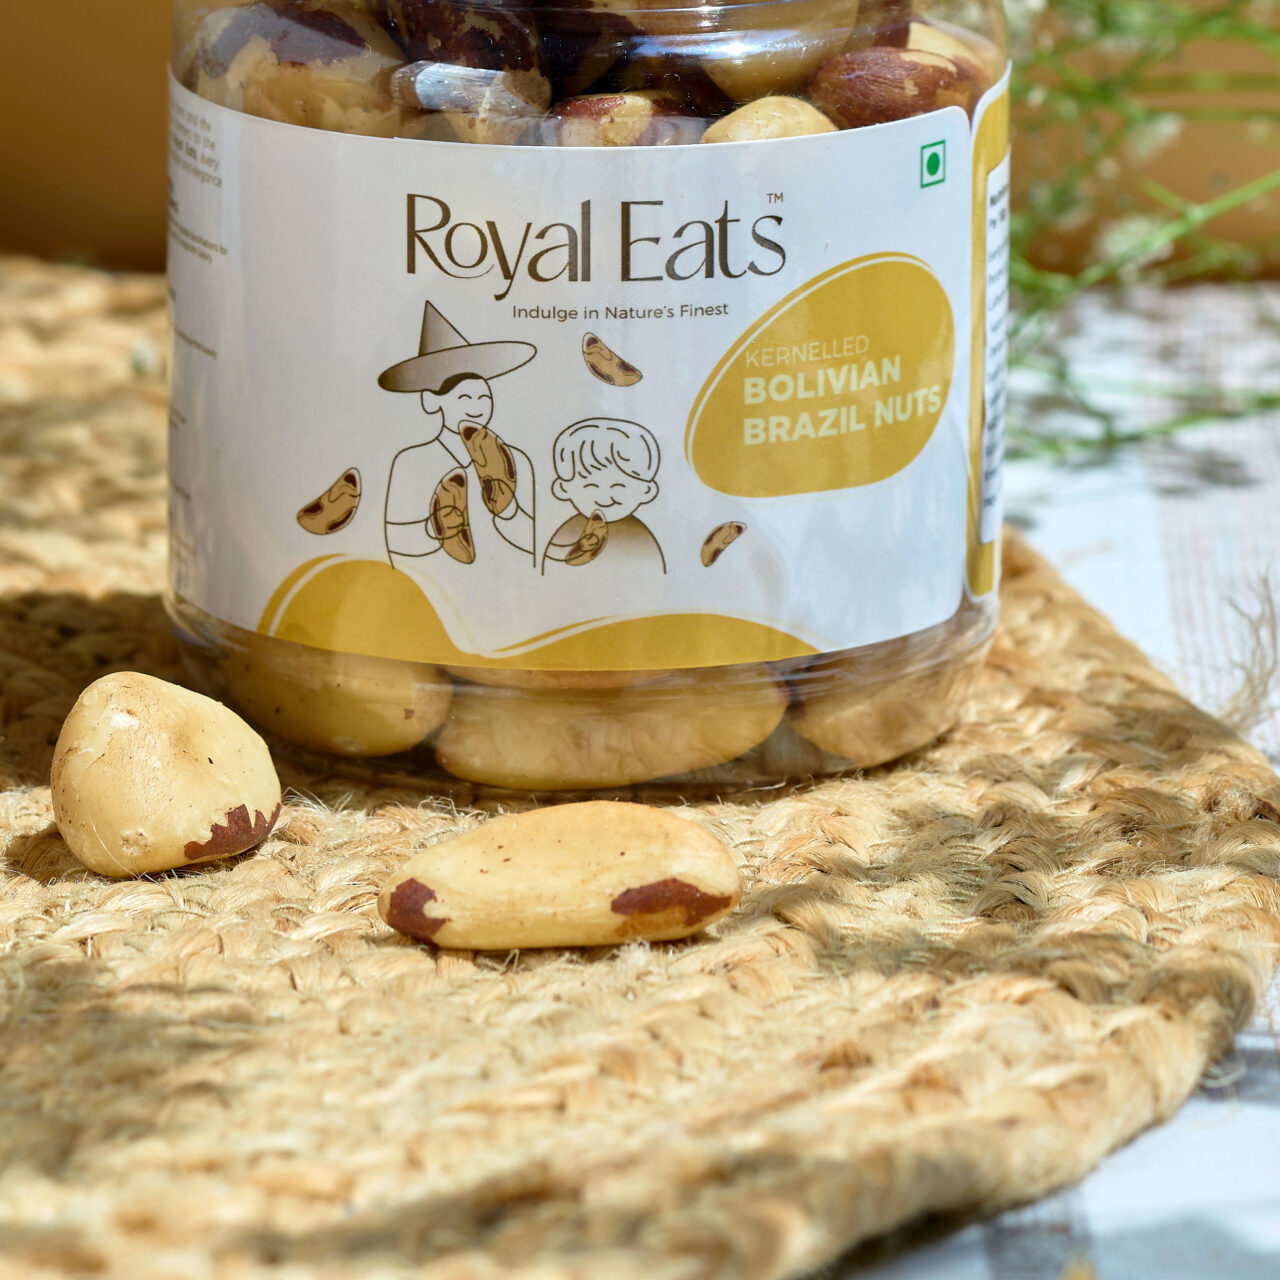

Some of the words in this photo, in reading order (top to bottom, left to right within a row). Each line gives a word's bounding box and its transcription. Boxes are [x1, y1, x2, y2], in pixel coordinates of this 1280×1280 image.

[406, 193, 592, 301] Royal
[620, 199, 787, 282] Eats
[512, 304, 577, 323] Indulge
[583, 305, 599, 319] in
[605, 304, 674, 320] Nature's
[680, 302, 729, 318] Finest
[745, 335, 870, 369] KERNELLED
[743, 355, 901, 405] BOLIVIAN
[743, 404, 867, 446] BRAZIL
[874, 384, 942, 428] NUTS
